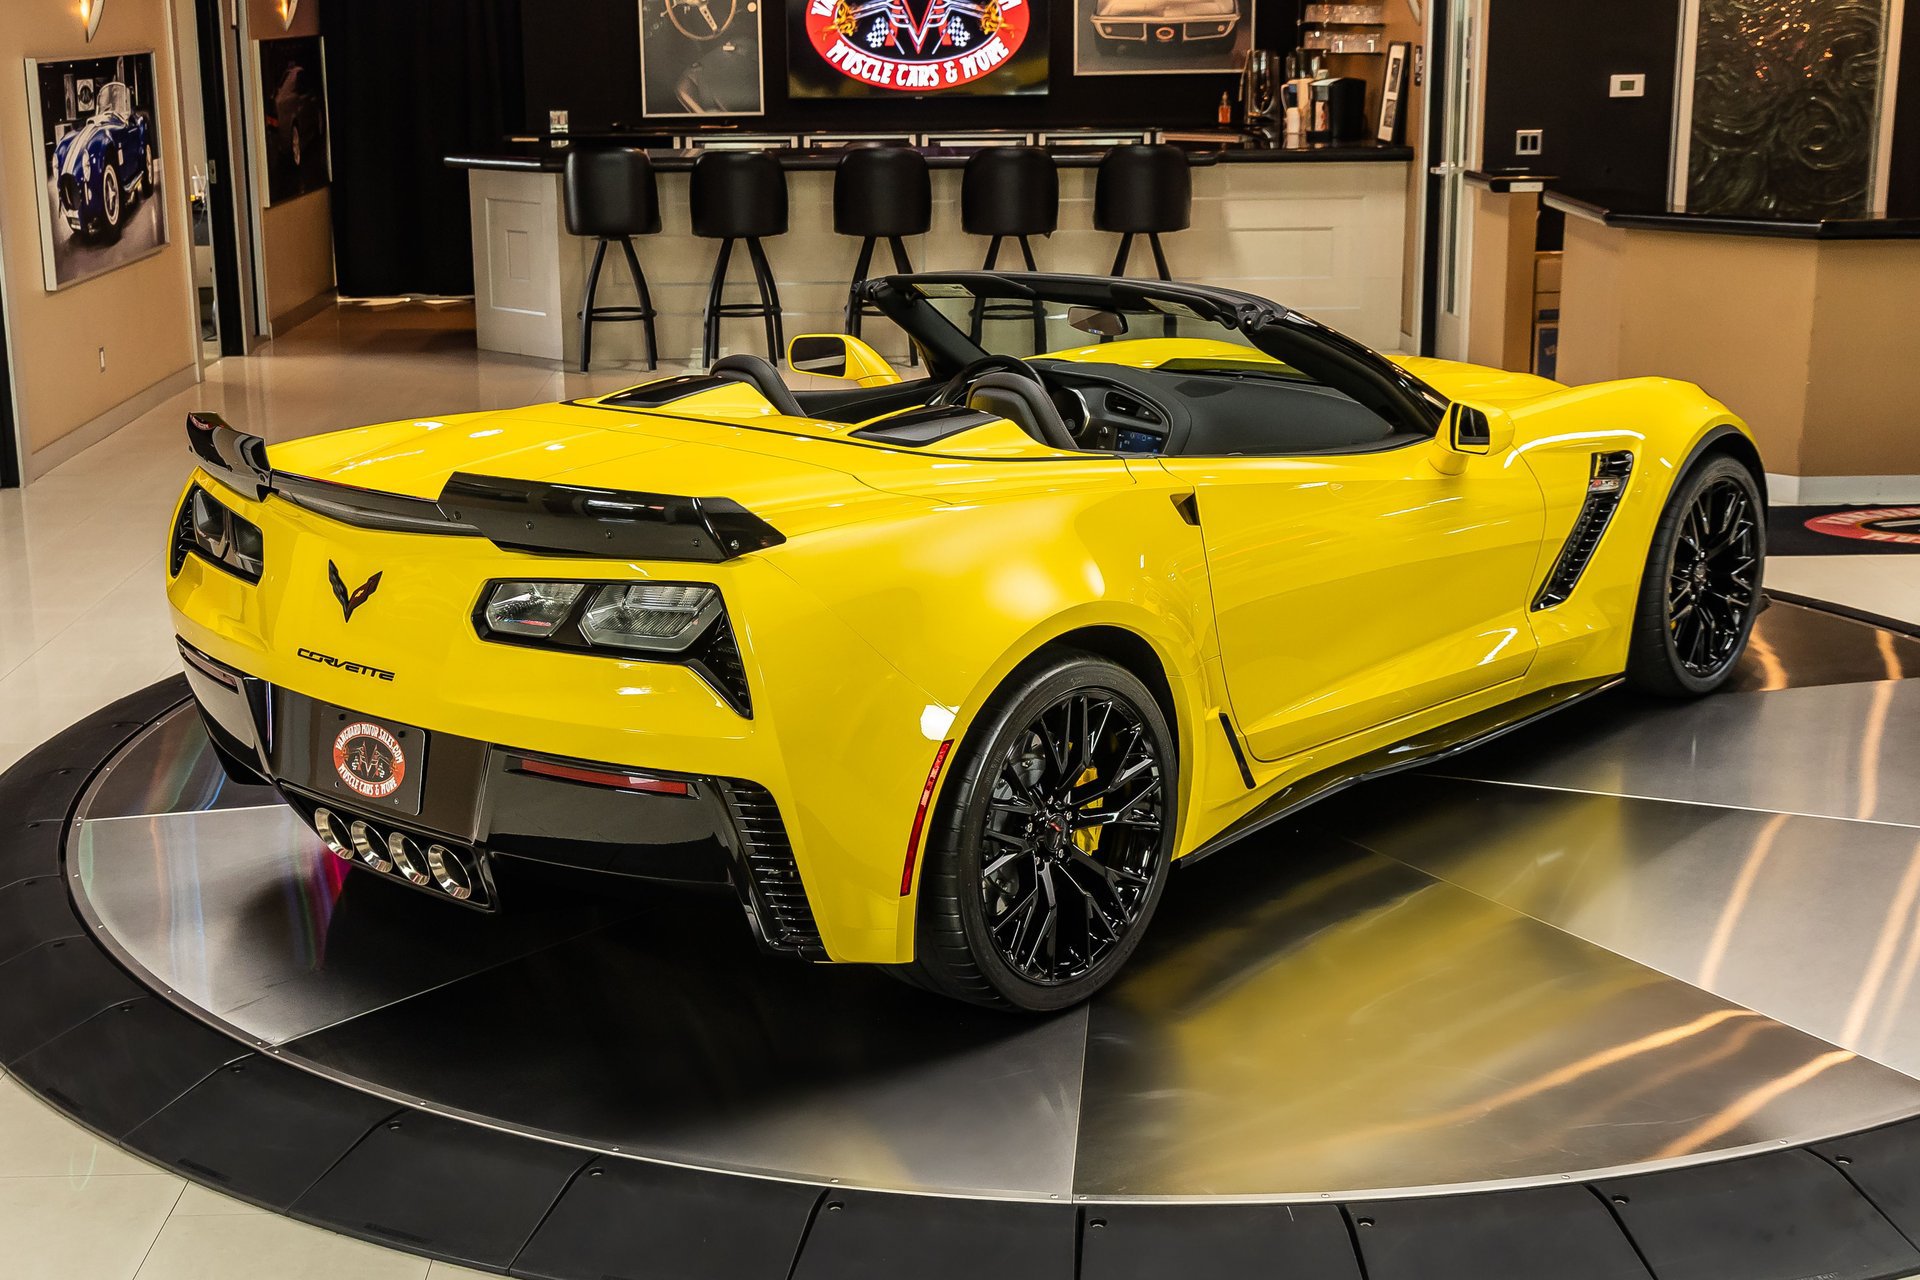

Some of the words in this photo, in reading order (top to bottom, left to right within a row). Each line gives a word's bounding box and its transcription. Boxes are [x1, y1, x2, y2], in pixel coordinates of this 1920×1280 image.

[826, 39, 895, 85] MUSCLE
[896, 64, 940, 87] CARS
[943, 61, 958, 84] &
[959, 36, 1010, 79] MORE
[297, 648, 395, 681] CORVETTE
[335, 724, 361, 750] VANGUARD
[361, 723, 379, 737] MOTOR
[338, 763, 360, 790] MUSCLE
[360, 784, 374, 796] CARS
[374, 784, 380, 796] &
[380, 777, 397, 795] MORE
